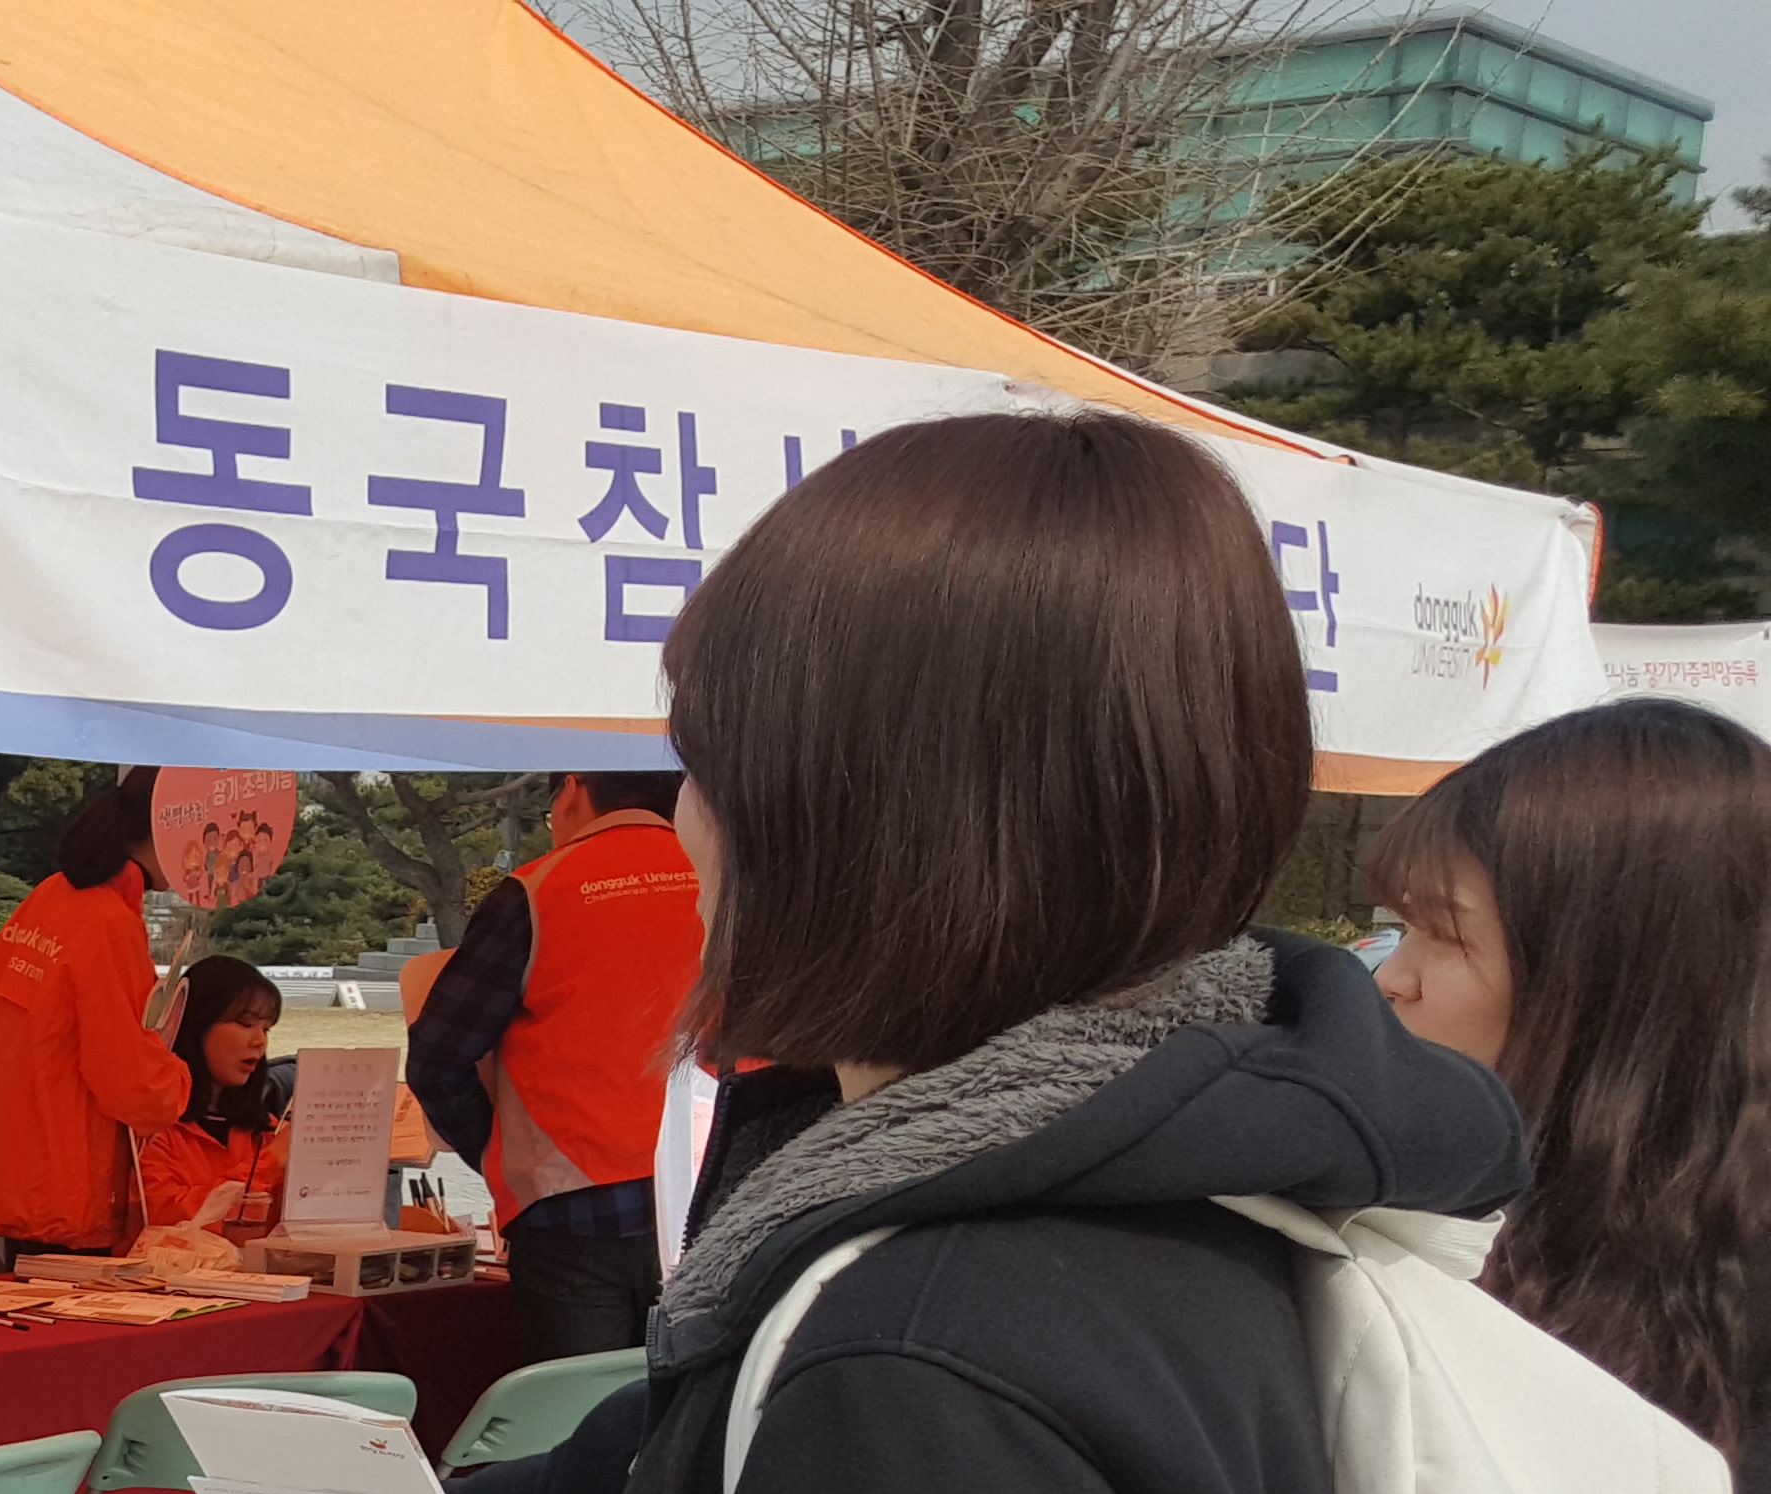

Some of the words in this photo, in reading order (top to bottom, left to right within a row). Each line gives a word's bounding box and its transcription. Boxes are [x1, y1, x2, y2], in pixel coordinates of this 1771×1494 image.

[1414, 582, 1477, 642] dongguk
[1604, 662, 1640, 688] 나눔
[1644, 660, 1759, 688] 장기기증희망등록
[580, 874, 642, 894] dongguk
[643, 870, 697, 883] Univers
